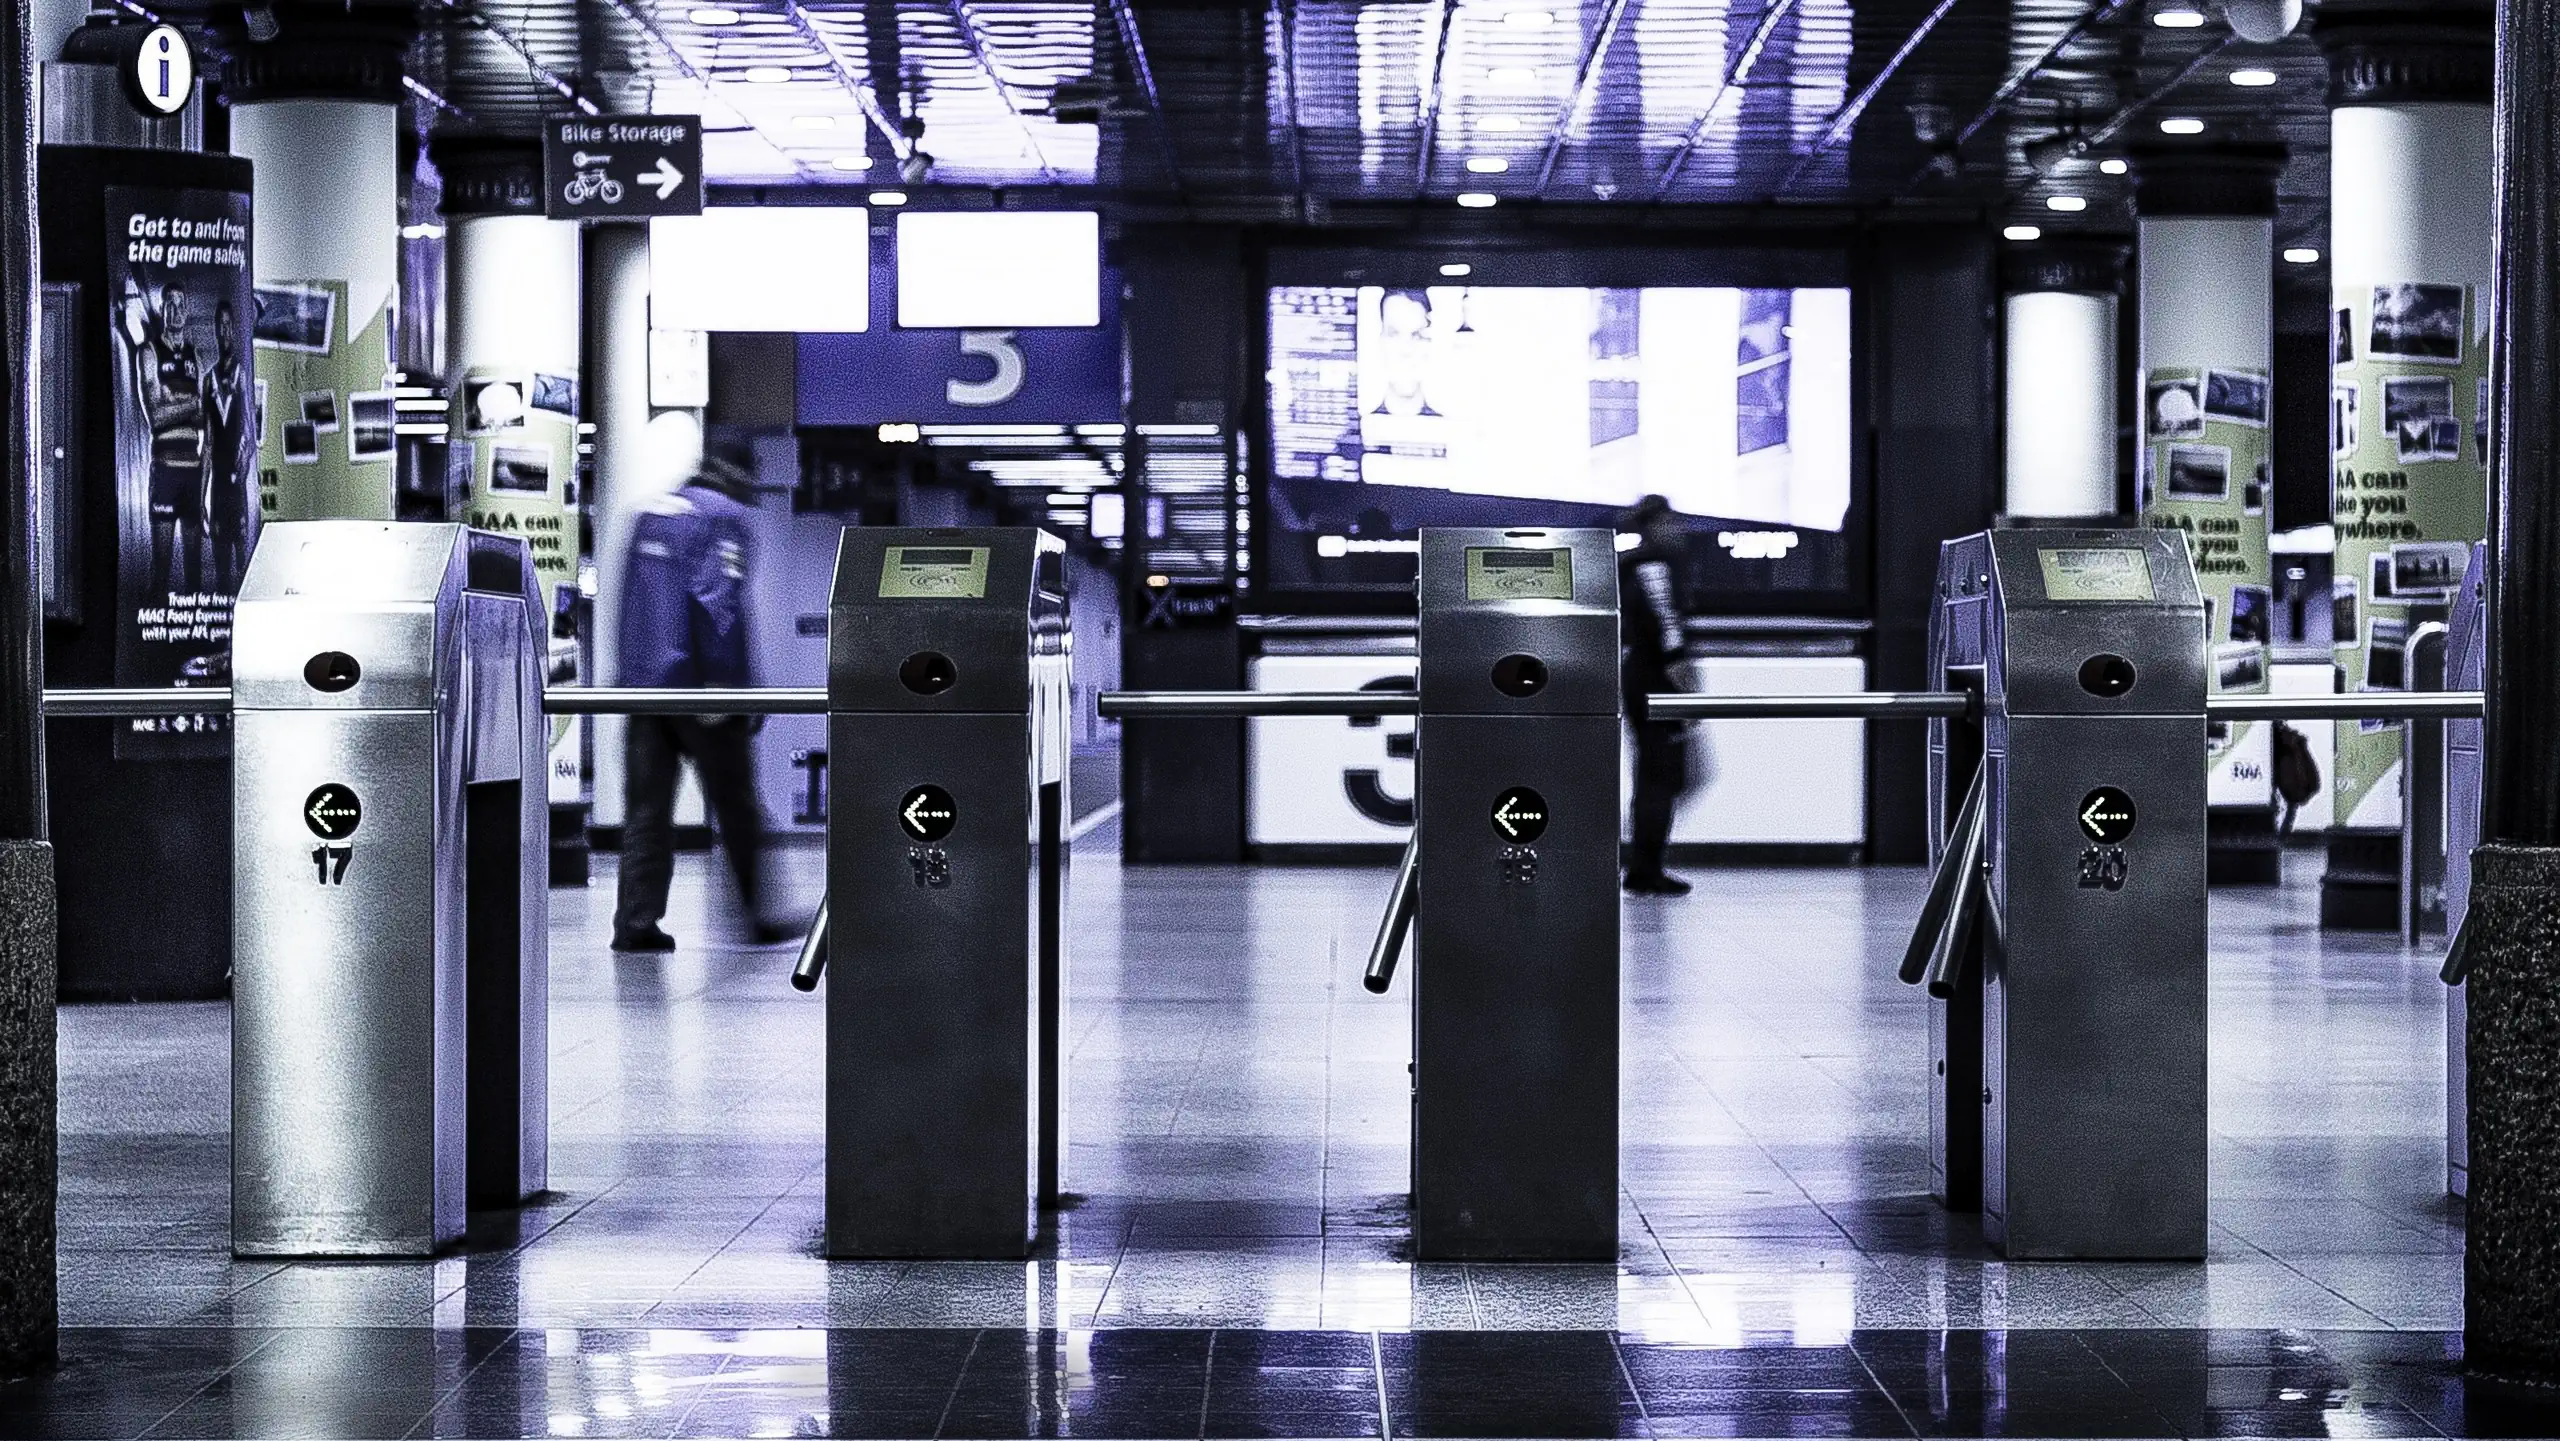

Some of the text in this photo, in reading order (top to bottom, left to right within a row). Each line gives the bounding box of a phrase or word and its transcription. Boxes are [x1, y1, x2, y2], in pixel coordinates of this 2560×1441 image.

[561, 123, 687, 146] Bike Storage
[129, 214, 245, 242] Get to and from
[128, 239, 164, 262] the
[166, 244, 211, 268] game
[2362, 471, 2408, 489] can
[2361, 494, 2407, 518] you
[525, 515, 560, 531] can
[2200, 518, 2240, 534] can
[2334, 514, 2423, 542] ywhere.
[168, 592, 197, 607] Travel
[198, 592, 211, 606] for
[168, 627, 191, 643] your
[311, 843, 354, 886] 17
[2079, 846, 2129, 891] 20
